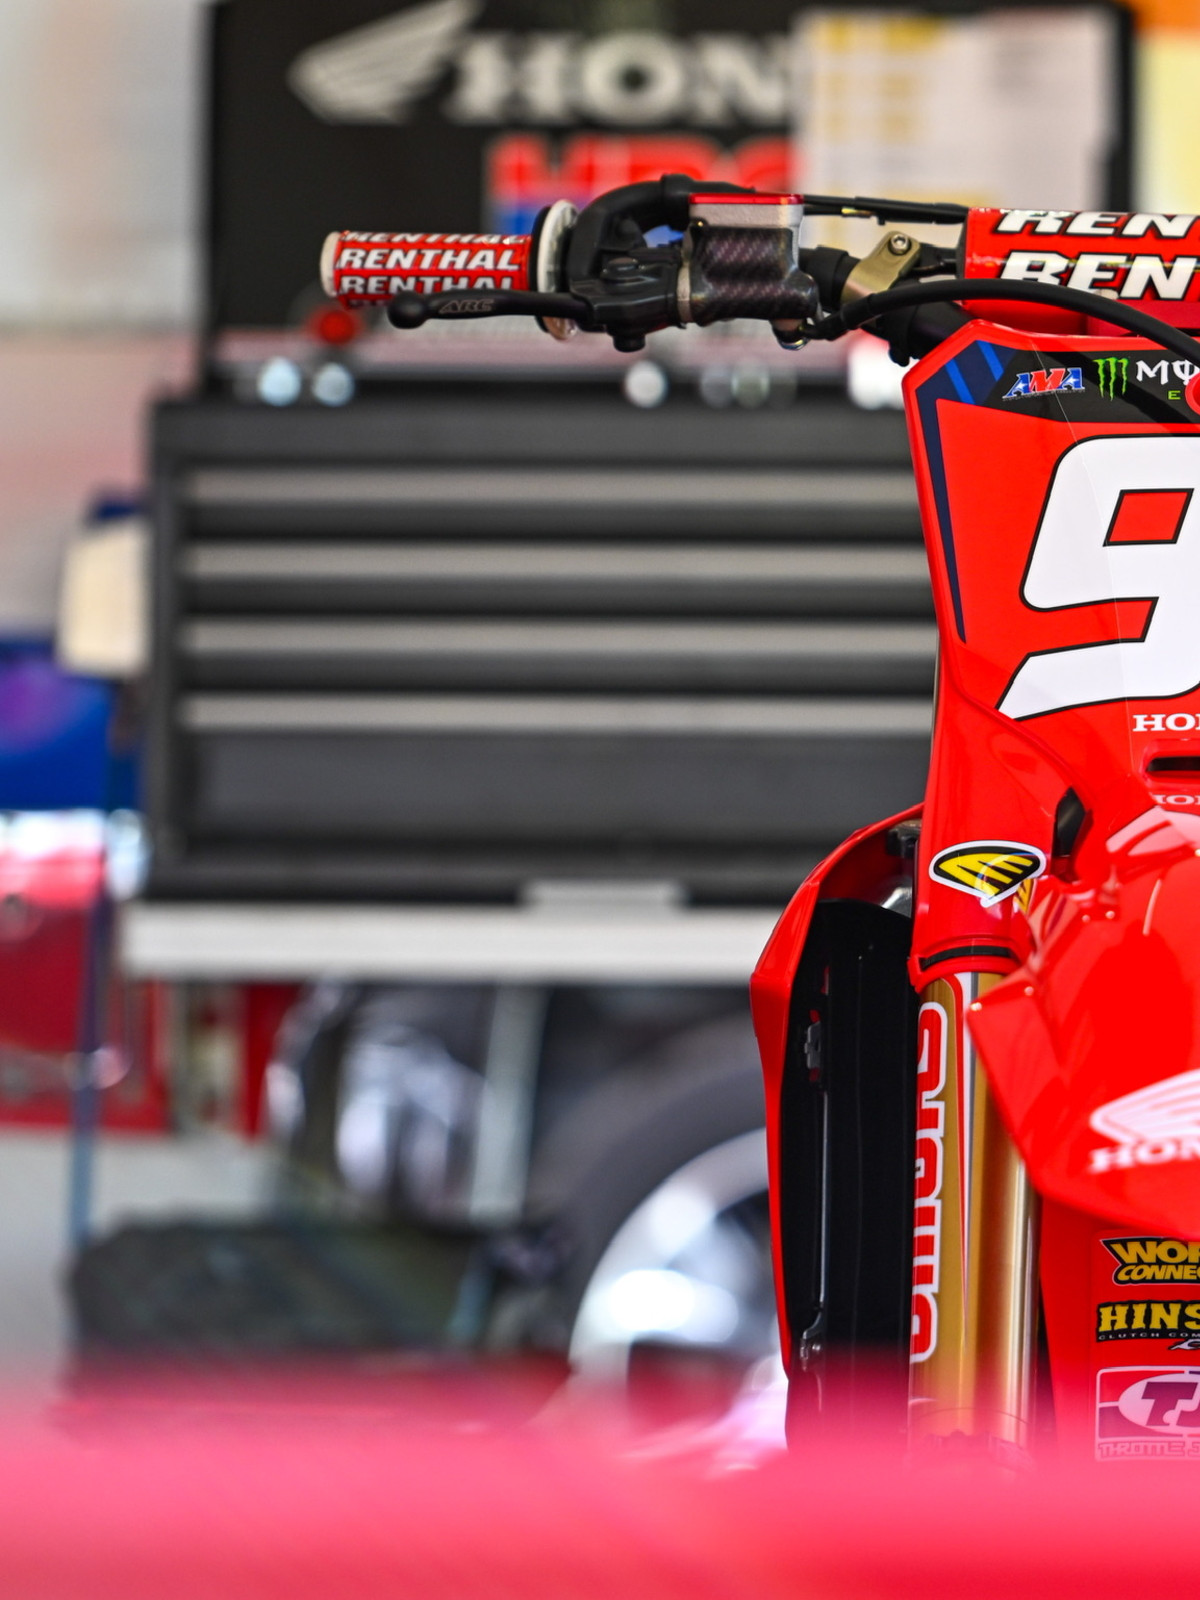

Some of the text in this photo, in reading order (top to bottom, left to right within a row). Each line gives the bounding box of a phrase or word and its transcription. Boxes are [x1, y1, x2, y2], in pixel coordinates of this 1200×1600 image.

[337, 248, 520, 271] RENTHAL
[439, 300, 494, 314] ARC
[1002, 367, 1085, 399] AMA
[1098, 1332, 1160, 1341] CLUTCH
[1098, 1440, 1186, 1458] THROTTLE
